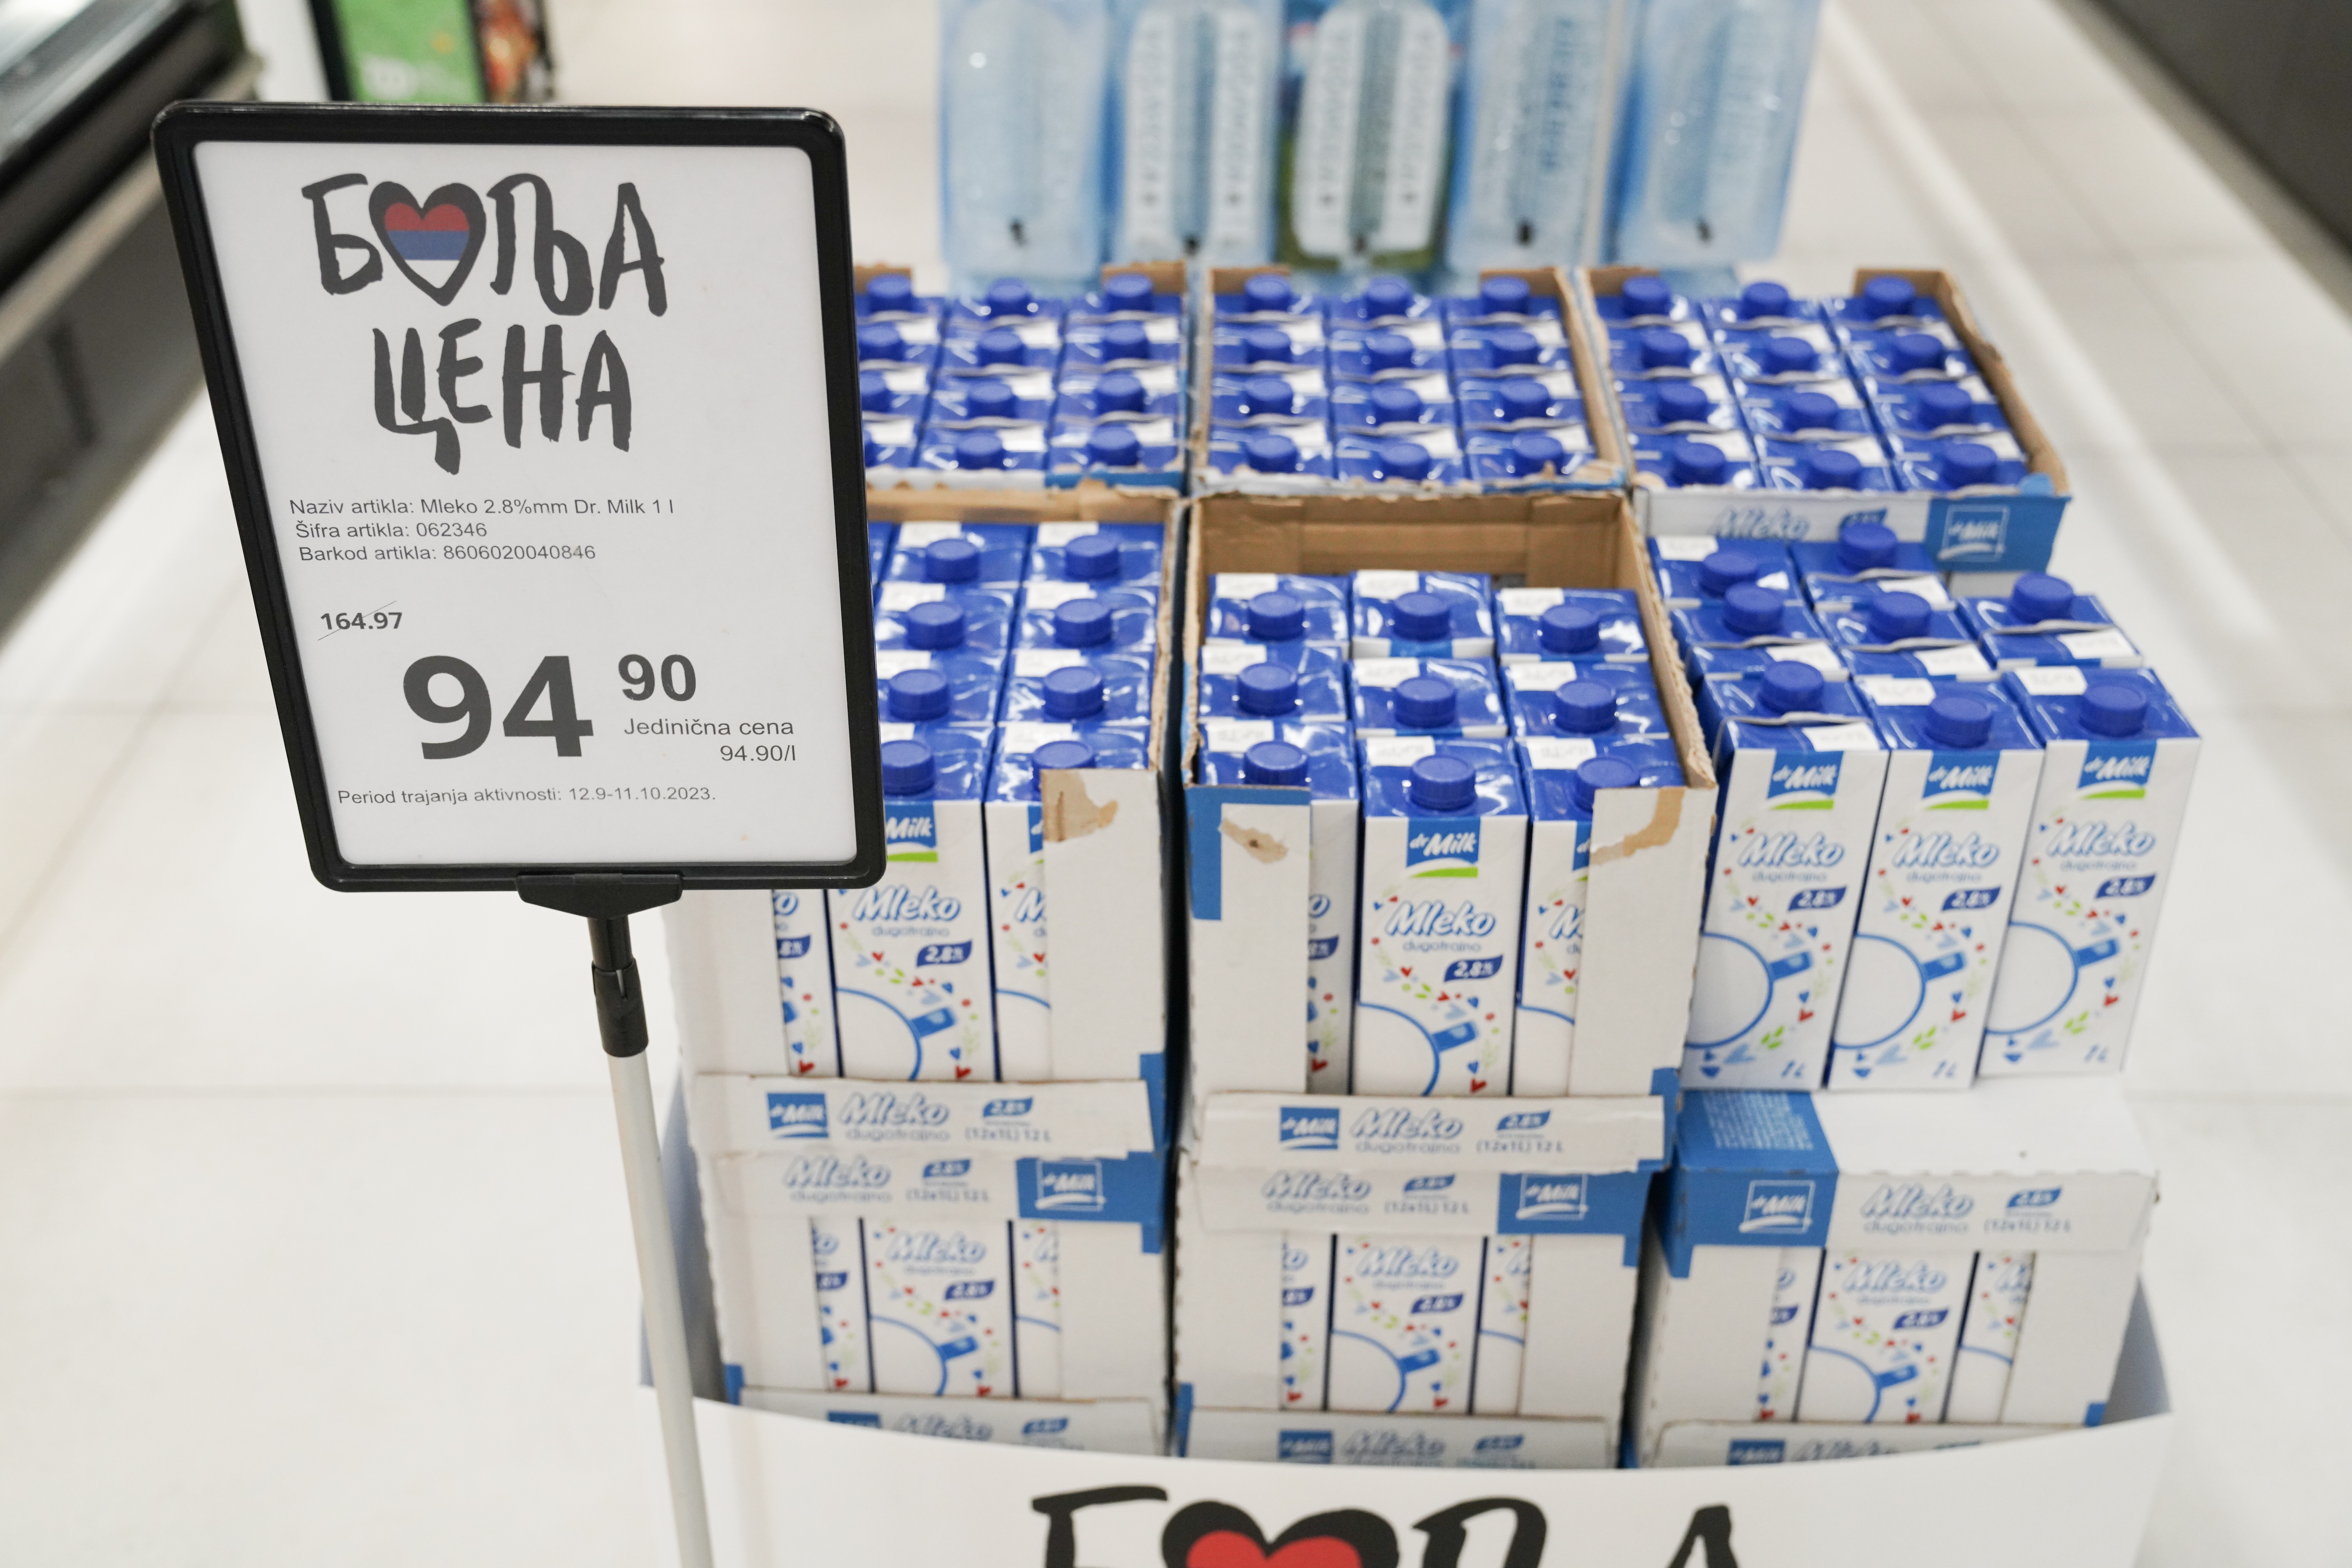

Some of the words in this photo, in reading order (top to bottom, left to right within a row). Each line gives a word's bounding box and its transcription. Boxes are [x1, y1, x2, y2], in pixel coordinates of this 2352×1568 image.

[372, 318, 632, 475] ЦЕНА
[290, 499, 344, 514] Naziv
[351, 499, 414, 514] artikla:
[421, 499, 478, 514] Mleko
[484, 499, 568, 514] 2.8%mm
[574, 499, 600, 514] Dr.
[608, 499, 646, 514] Milk
[653, 499, 660, 514] 1
[296, 520, 340, 538] Šifra
[347, 523, 409, 537] artikla:
[416, 523, 487, 537] 062346
[299, 546, 368, 561] Barkod
[374, 546, 436, 560] artikla:
[444, 545, 596, 560] 8606020040846
[320, 612, 403, 630] 164.97
[403, 655, 593, 760] 94
[618, 654, 696, 702] 90
[624, 718, 731, 735] Jedinična
[739, 722, 793, 735] cena
[720, 745, 796, 762] 94.90/l
[338, 790, 396, 804] Period
[401, 789, 468, 806] trajanja
[474, 788, 562, 801] aktivnosti:
[569, 787, 716, 800] 12.9-11.10.2023.
[1423, 832, 1477, 857] Milk
[1737, 831, 1845, 867] Mleko
[1892, 831, 2000, 868] Mleko
[2045, 821, 2156, 858] Mleko
[851, 885, 961, 922] Mleko
[1384, 900, 1495, 937] Mleko
[838, 1092, 950, 1126] Mleko
[1350, 1107, 1464, 1139] Mleko
